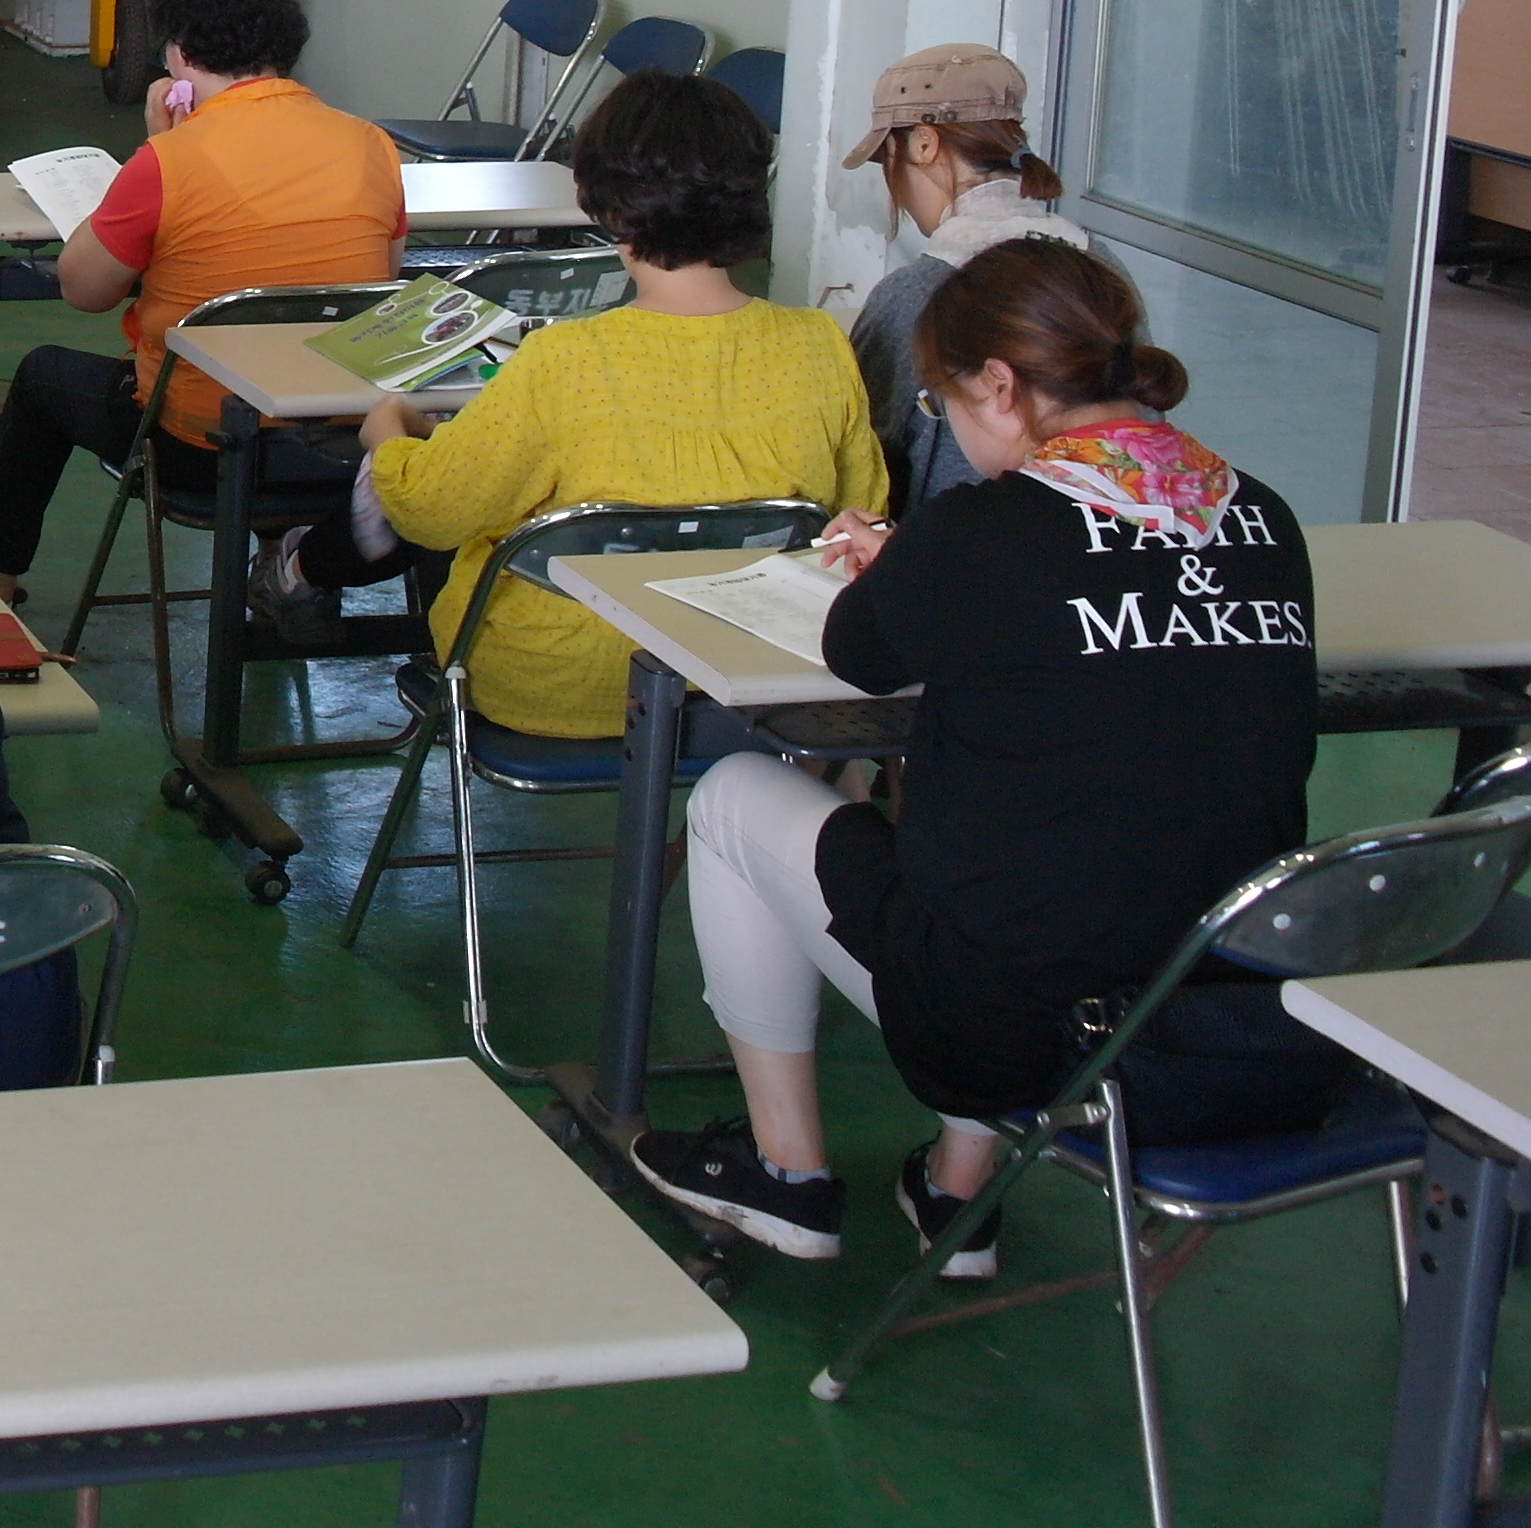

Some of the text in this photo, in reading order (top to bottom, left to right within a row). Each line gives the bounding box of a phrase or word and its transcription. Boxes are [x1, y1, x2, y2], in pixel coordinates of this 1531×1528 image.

[505, 289, 592, 315] 동부지
[1071, 502, 1278, 553] FAH
[1177, 554, 1224, 597] &
[1066, 592, 1313, 655] MAKES.
